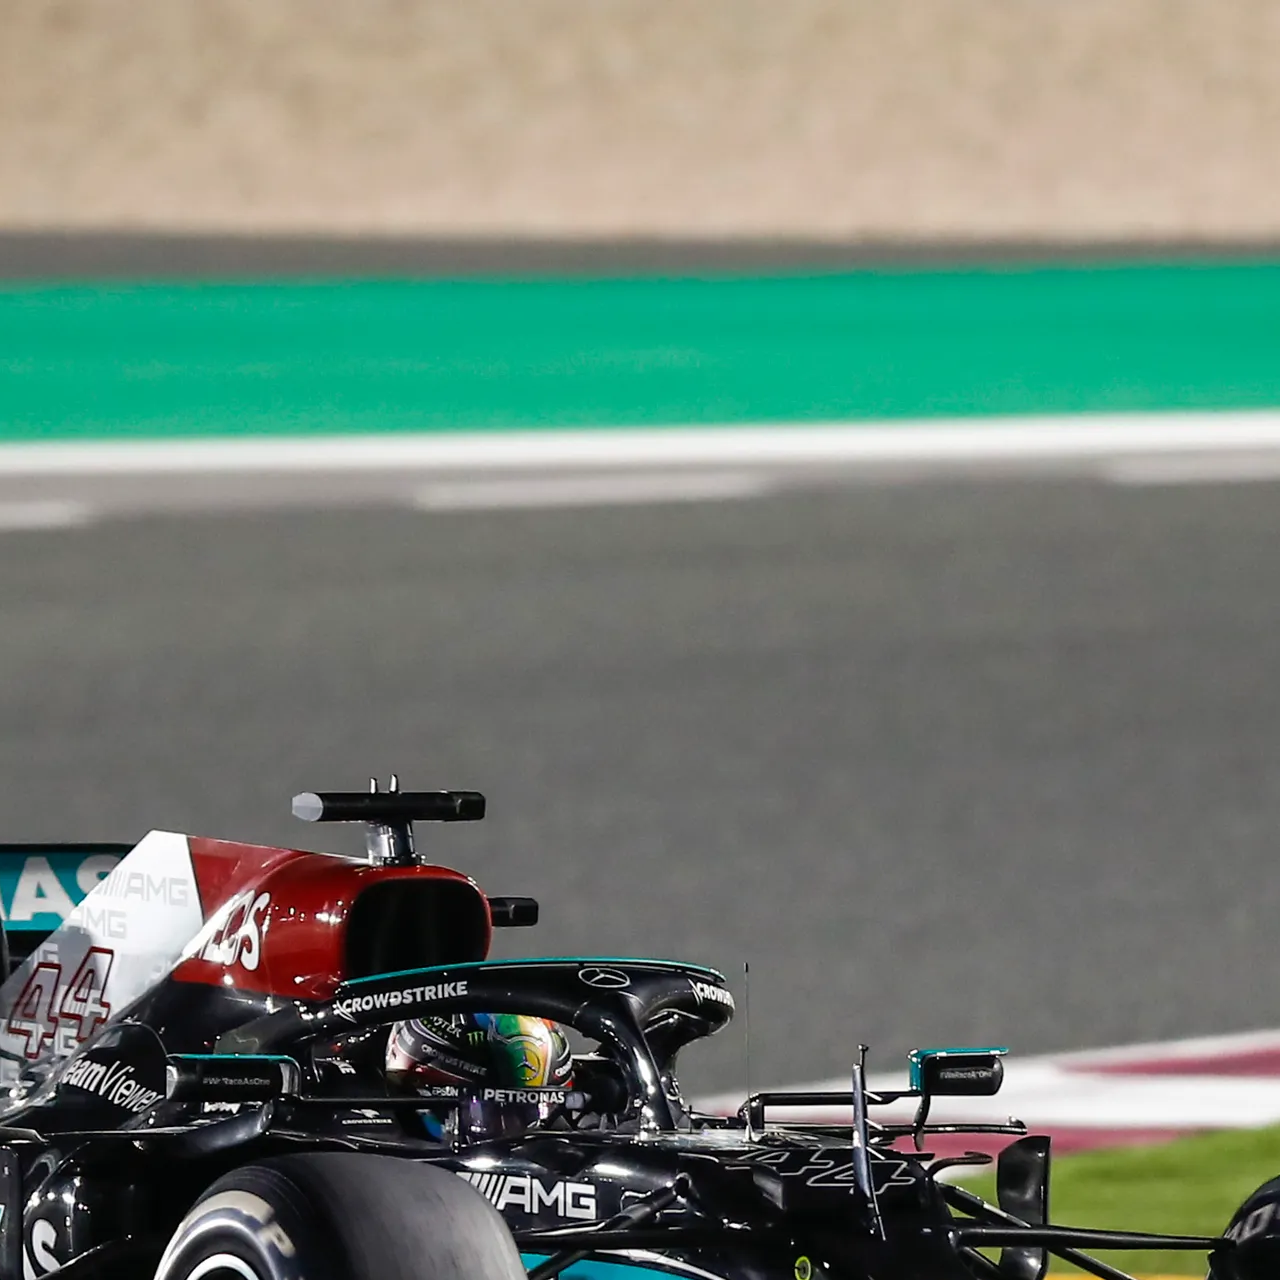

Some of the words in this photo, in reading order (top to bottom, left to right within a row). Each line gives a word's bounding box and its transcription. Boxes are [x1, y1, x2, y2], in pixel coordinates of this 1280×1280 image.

[124, 872, 188, 907] AMG
[8, 945, 114, 1059] 44
[342, 981, 468, 1013] CROWDSTRIKE
[62, 1055, 165, 1113] eamViewer
[483, 1088, 565, 1104] PETRONAS
[495, 1175, 597, 1220] AMG
